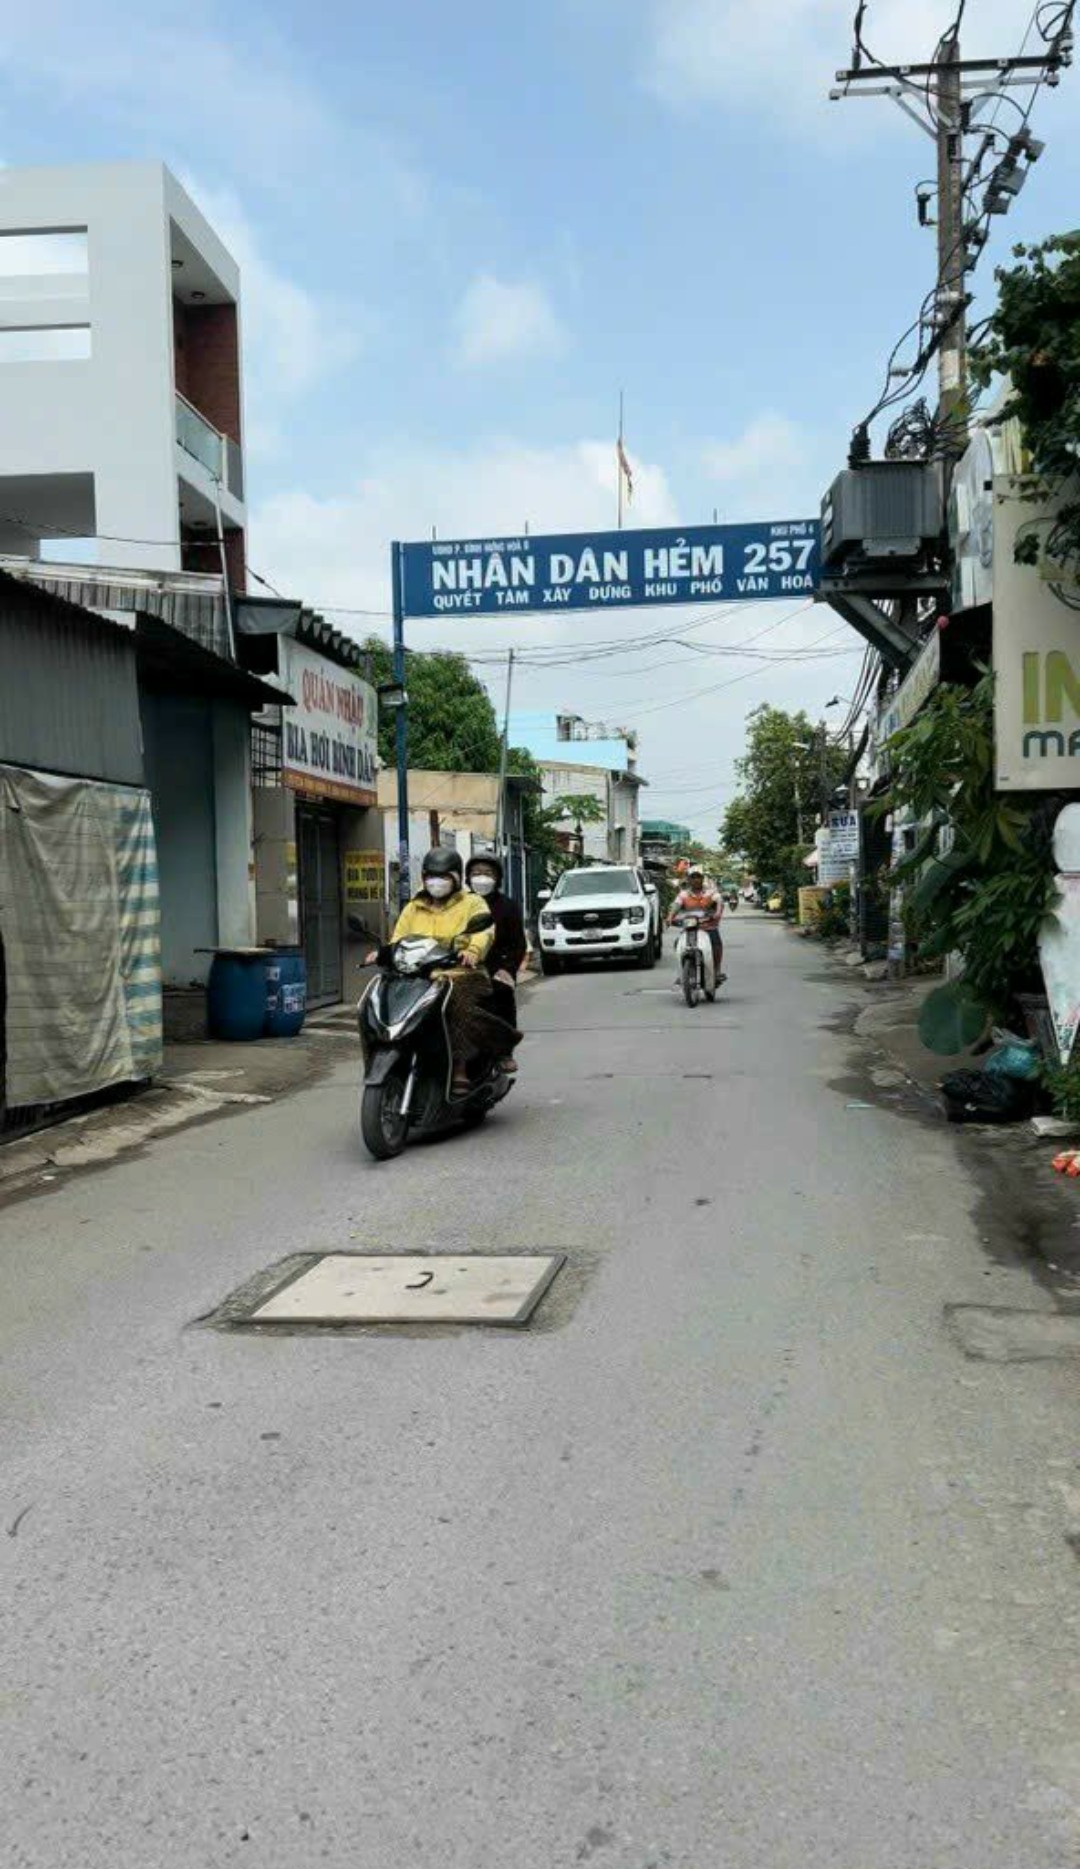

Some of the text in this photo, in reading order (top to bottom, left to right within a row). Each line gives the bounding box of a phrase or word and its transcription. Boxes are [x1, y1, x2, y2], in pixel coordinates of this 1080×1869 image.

[432, 537, 815, 590] NHÂN DÂN HẺM 257
[542, 586, 572, 603] XÂY
[645, 582, 677, 597] KHU
[691, 576, 722, 594] PHỐ
[302, 666, 334, 713] QUÁN
[286, 721, 308, 765] BIA
